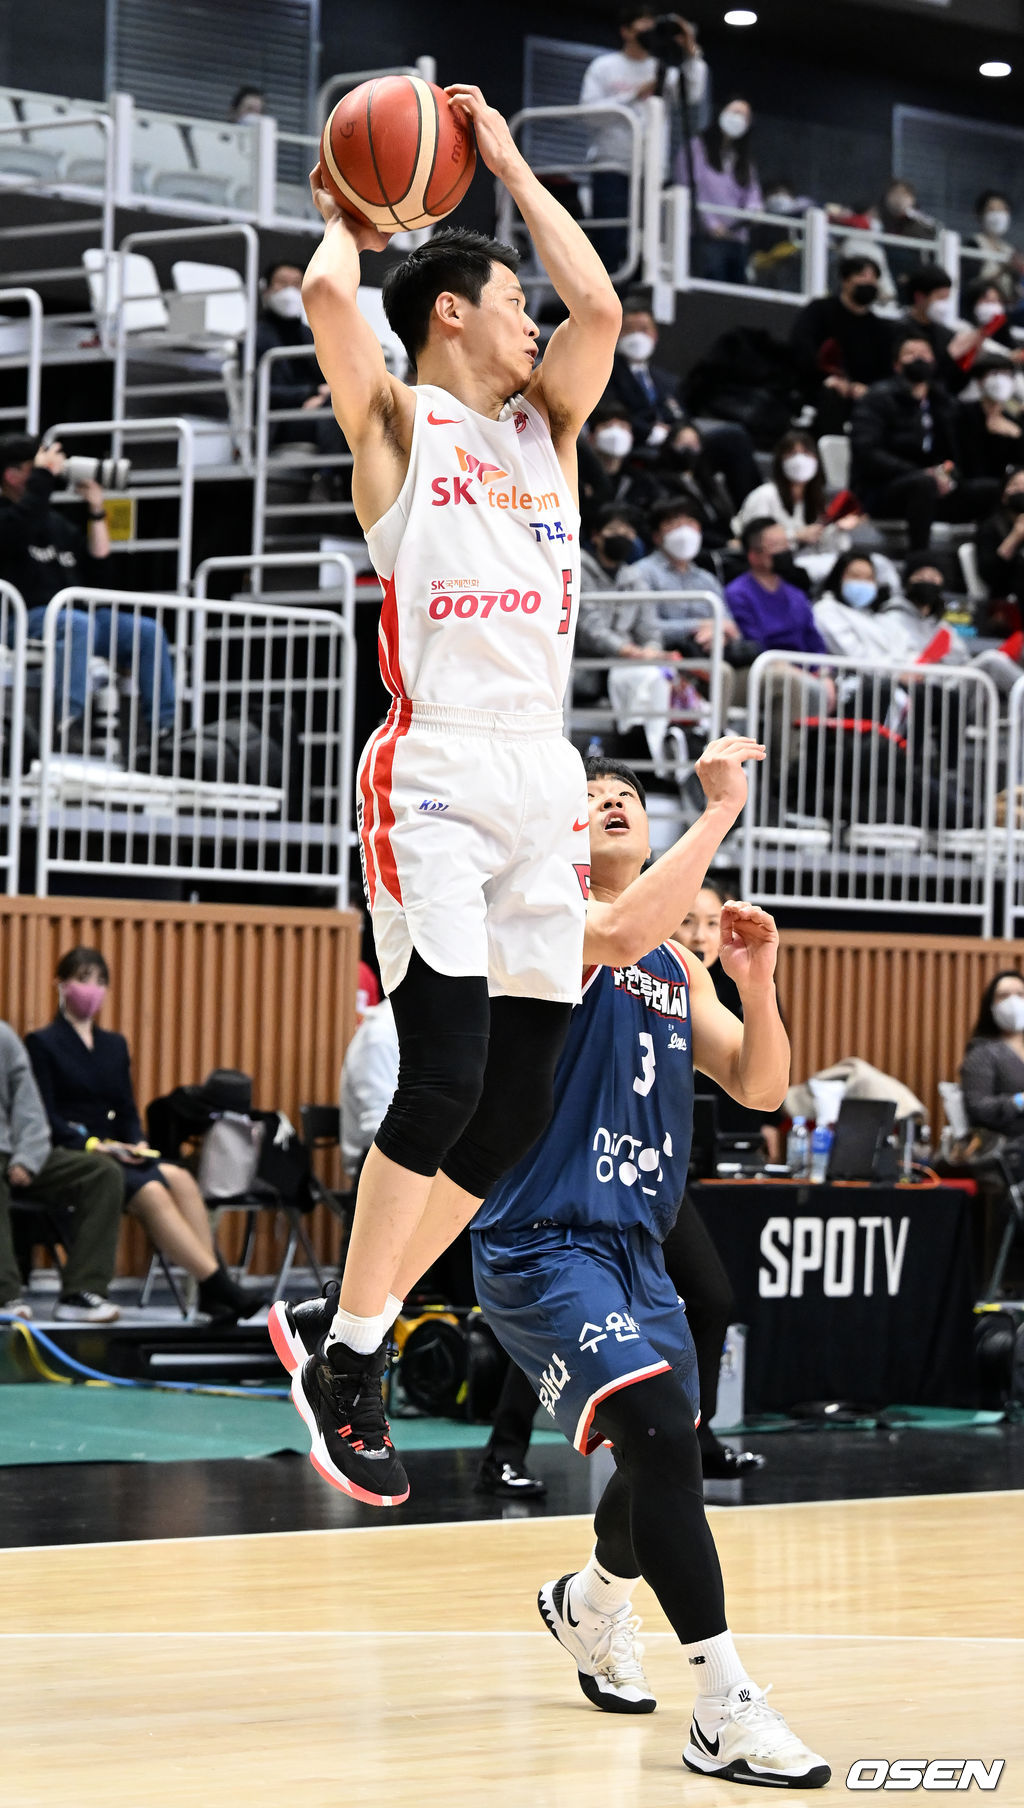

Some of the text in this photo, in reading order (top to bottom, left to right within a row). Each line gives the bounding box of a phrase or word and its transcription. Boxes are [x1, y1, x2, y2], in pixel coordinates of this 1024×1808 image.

[431, 476, 478, 507] SK
[428, 588, 542, 620] 00700
[632, 1031, 657, 1098] 3
[757, 1215, 911, 1299] SPOTV
